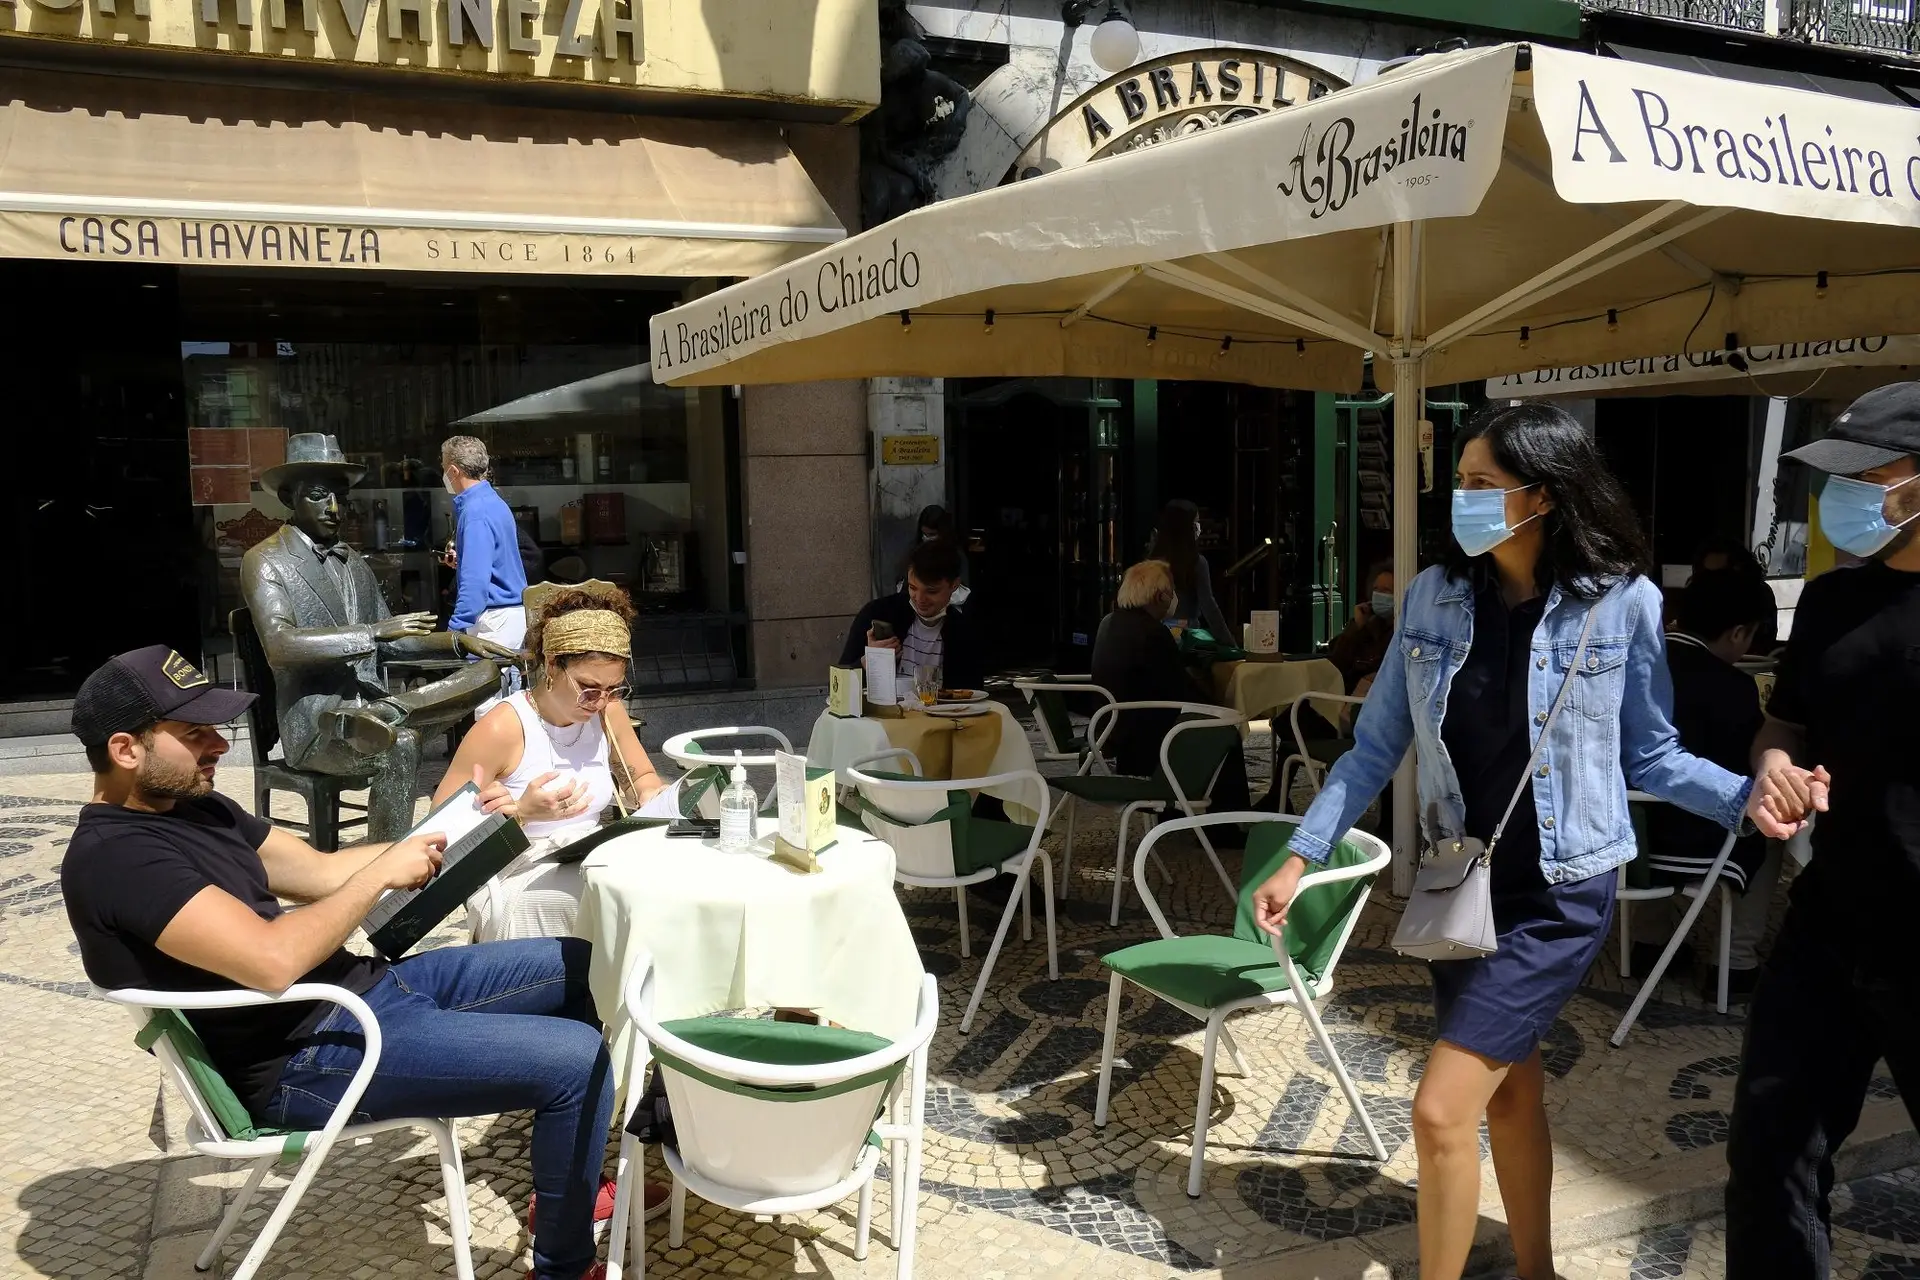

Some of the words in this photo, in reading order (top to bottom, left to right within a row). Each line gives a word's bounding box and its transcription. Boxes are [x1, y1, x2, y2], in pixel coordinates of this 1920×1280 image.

[1082, 104, 1114, 149] A
[1311, 92, 1467, 220] Brasileira
[1572, 79, 1628, 163] A
[1631, 87, 1894, 198] Brasileira
[58, 216, 159, 257] CASA
[181, 222, 381, 264] HAVANEZA
[426, 240, 539, 263] SINCE
[564, 244, 637, 264] 1864
[658, 329, 673, 369] A
[677, 301, 772, 364] Brasileira
[780, 278, 809, 328] do
[817, 238, 920, 313] Chiado
